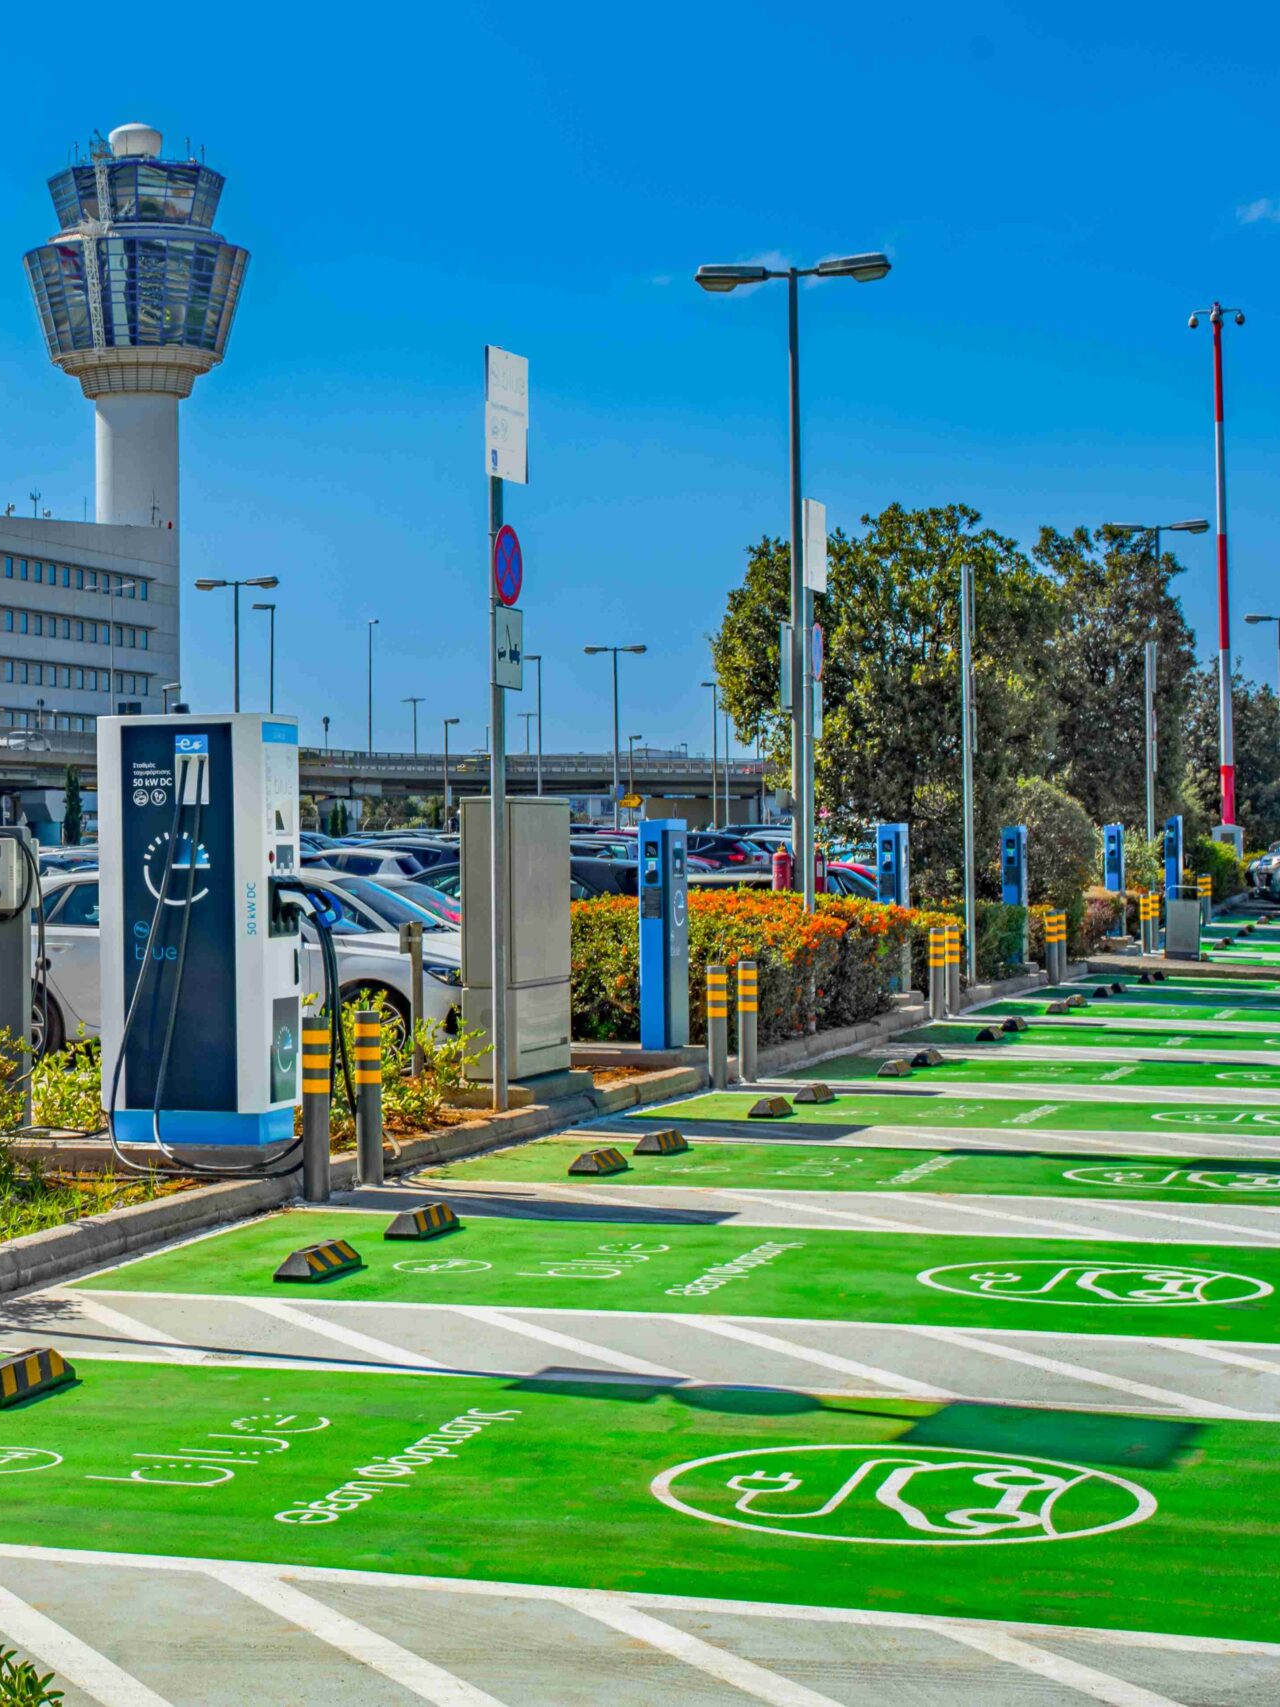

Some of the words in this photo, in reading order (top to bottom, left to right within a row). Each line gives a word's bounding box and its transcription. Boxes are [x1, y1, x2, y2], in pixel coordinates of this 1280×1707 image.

[133, 778, 144, 787] 50
[144, 777, 159, 787] kW
[160, 777, 173, 786] DC
[246, 882, 257, 899] DC
[246, 902, 257, 919] kW
[246, 922, 257, 936] 50
[134, 943, 178, 960] bue
[515, 1242, 671, 1279] blue
[84, 1412, 332, 1487] blue
[274, 1480, 411, 1524] Θέση
